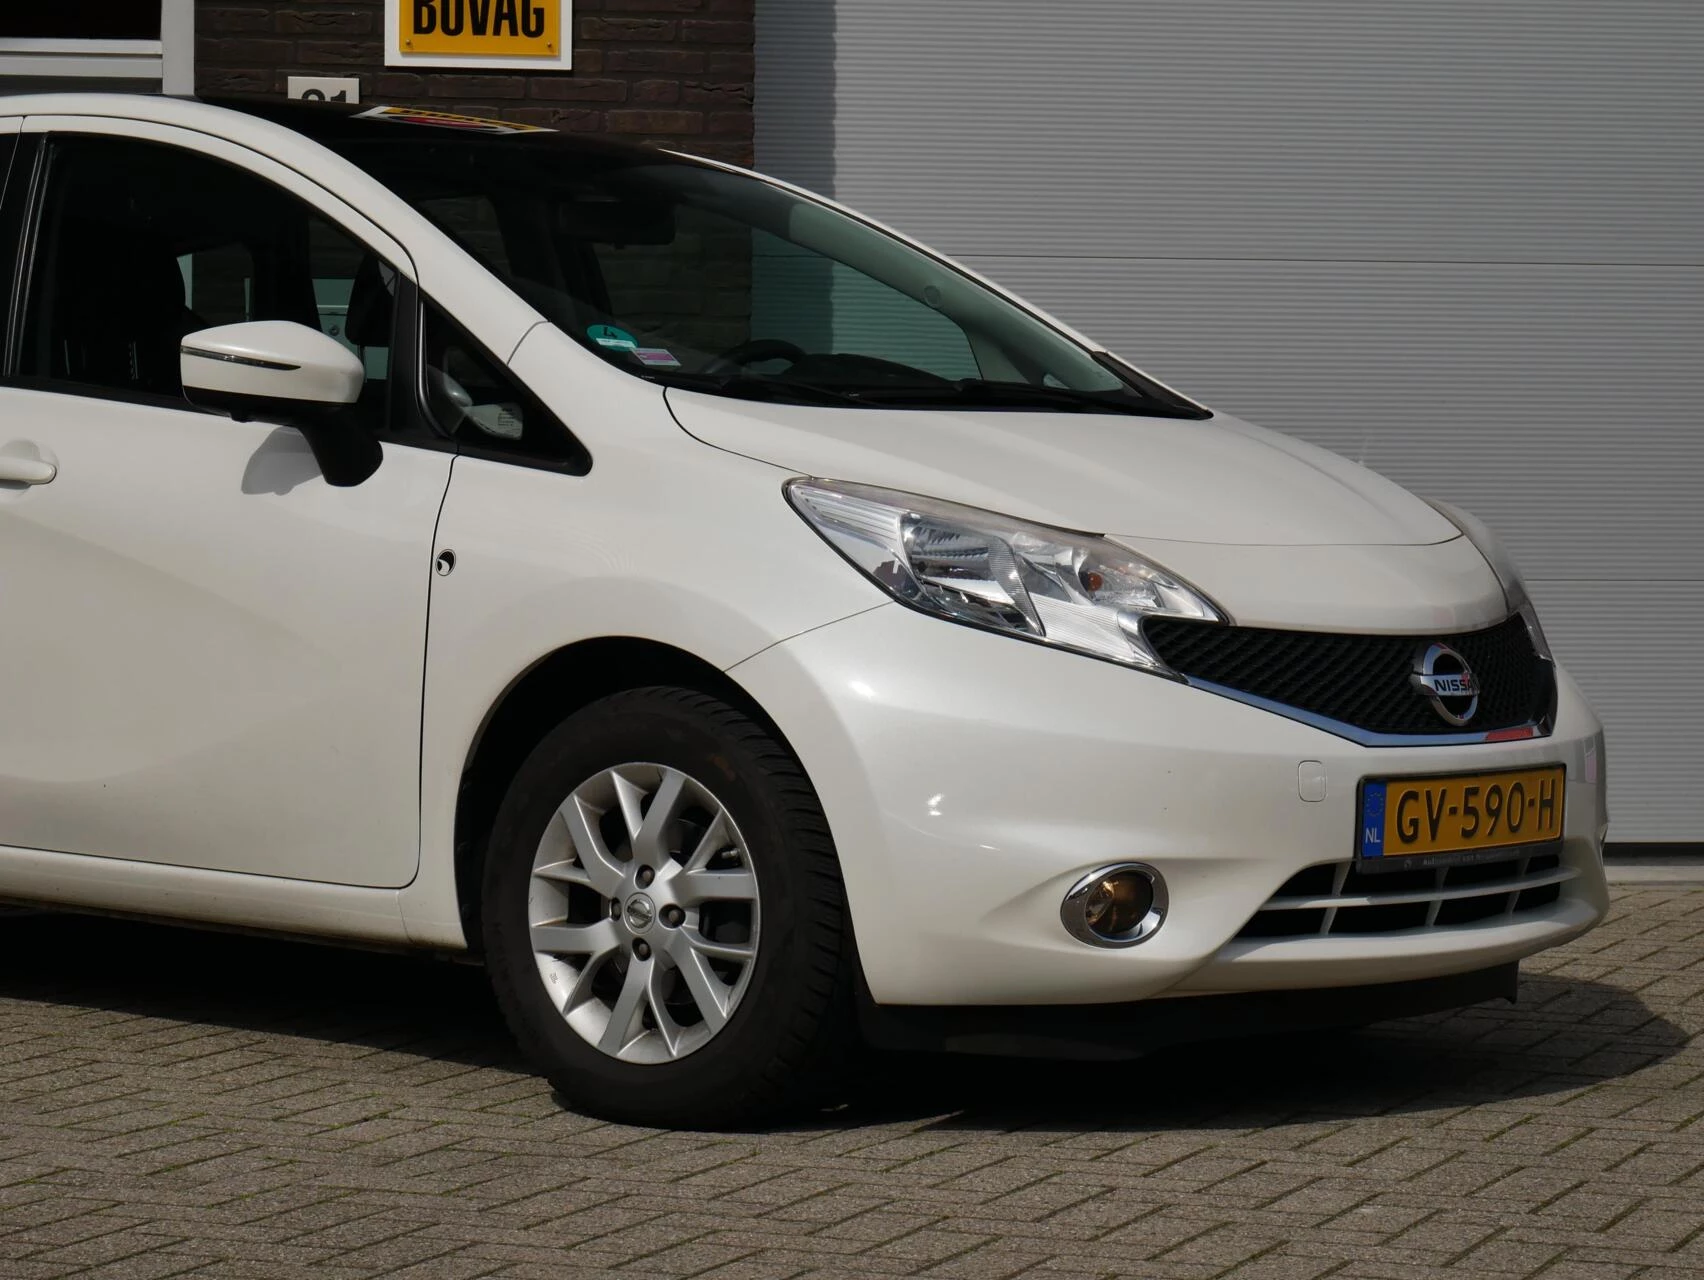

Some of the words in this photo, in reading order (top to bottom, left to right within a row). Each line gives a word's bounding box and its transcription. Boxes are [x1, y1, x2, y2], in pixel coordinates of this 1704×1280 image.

[413, 0, 545, 38] BOVAG
[1396, 779, 1556, 844] GV-590-H
[1365, 827, 1381, 843] NL
